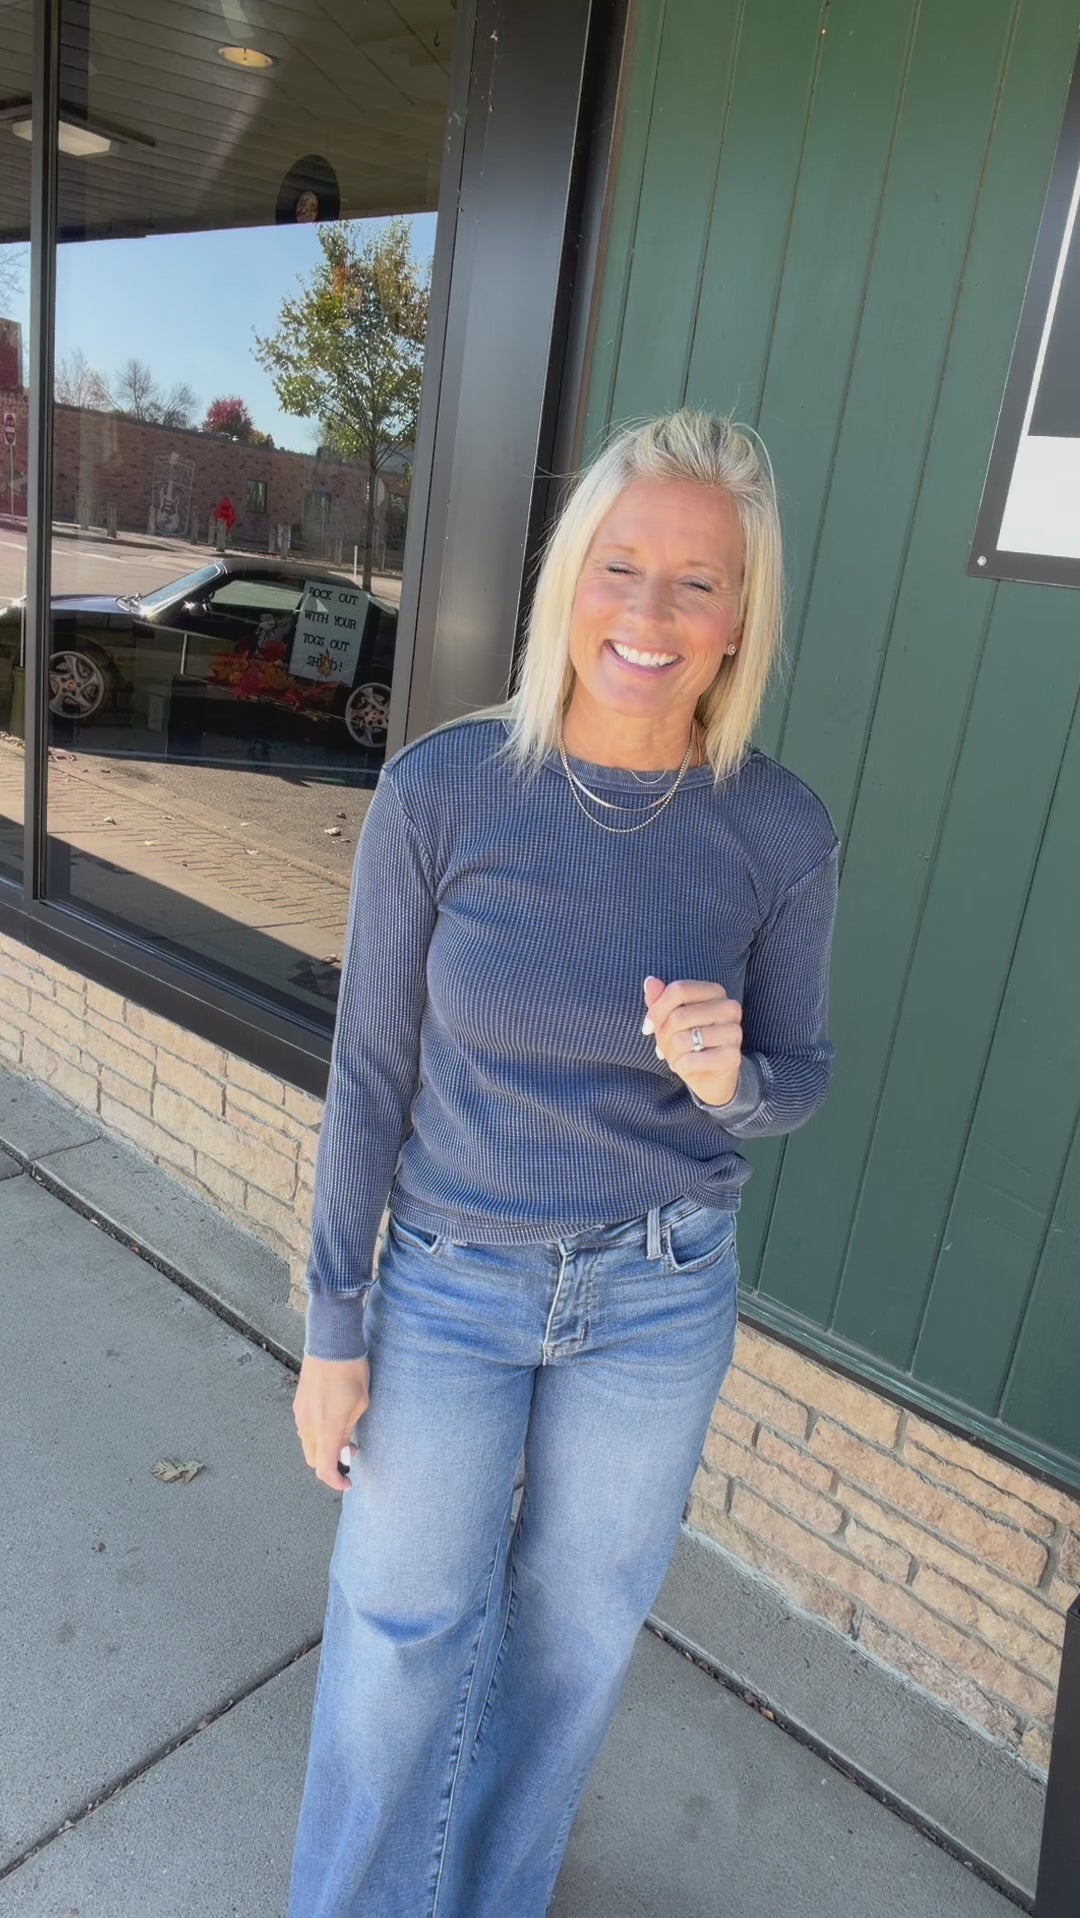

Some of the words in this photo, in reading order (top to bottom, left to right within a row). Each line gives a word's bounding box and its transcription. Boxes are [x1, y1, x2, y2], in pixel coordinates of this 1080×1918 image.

[309, 587, 332, 600] ROCK
[339, 593, 358, 605] OUT
[304, 609, 328, 623] WITH
[334, 615, 356, 629] YOUR
[330, 639, 350, 652] OUT
